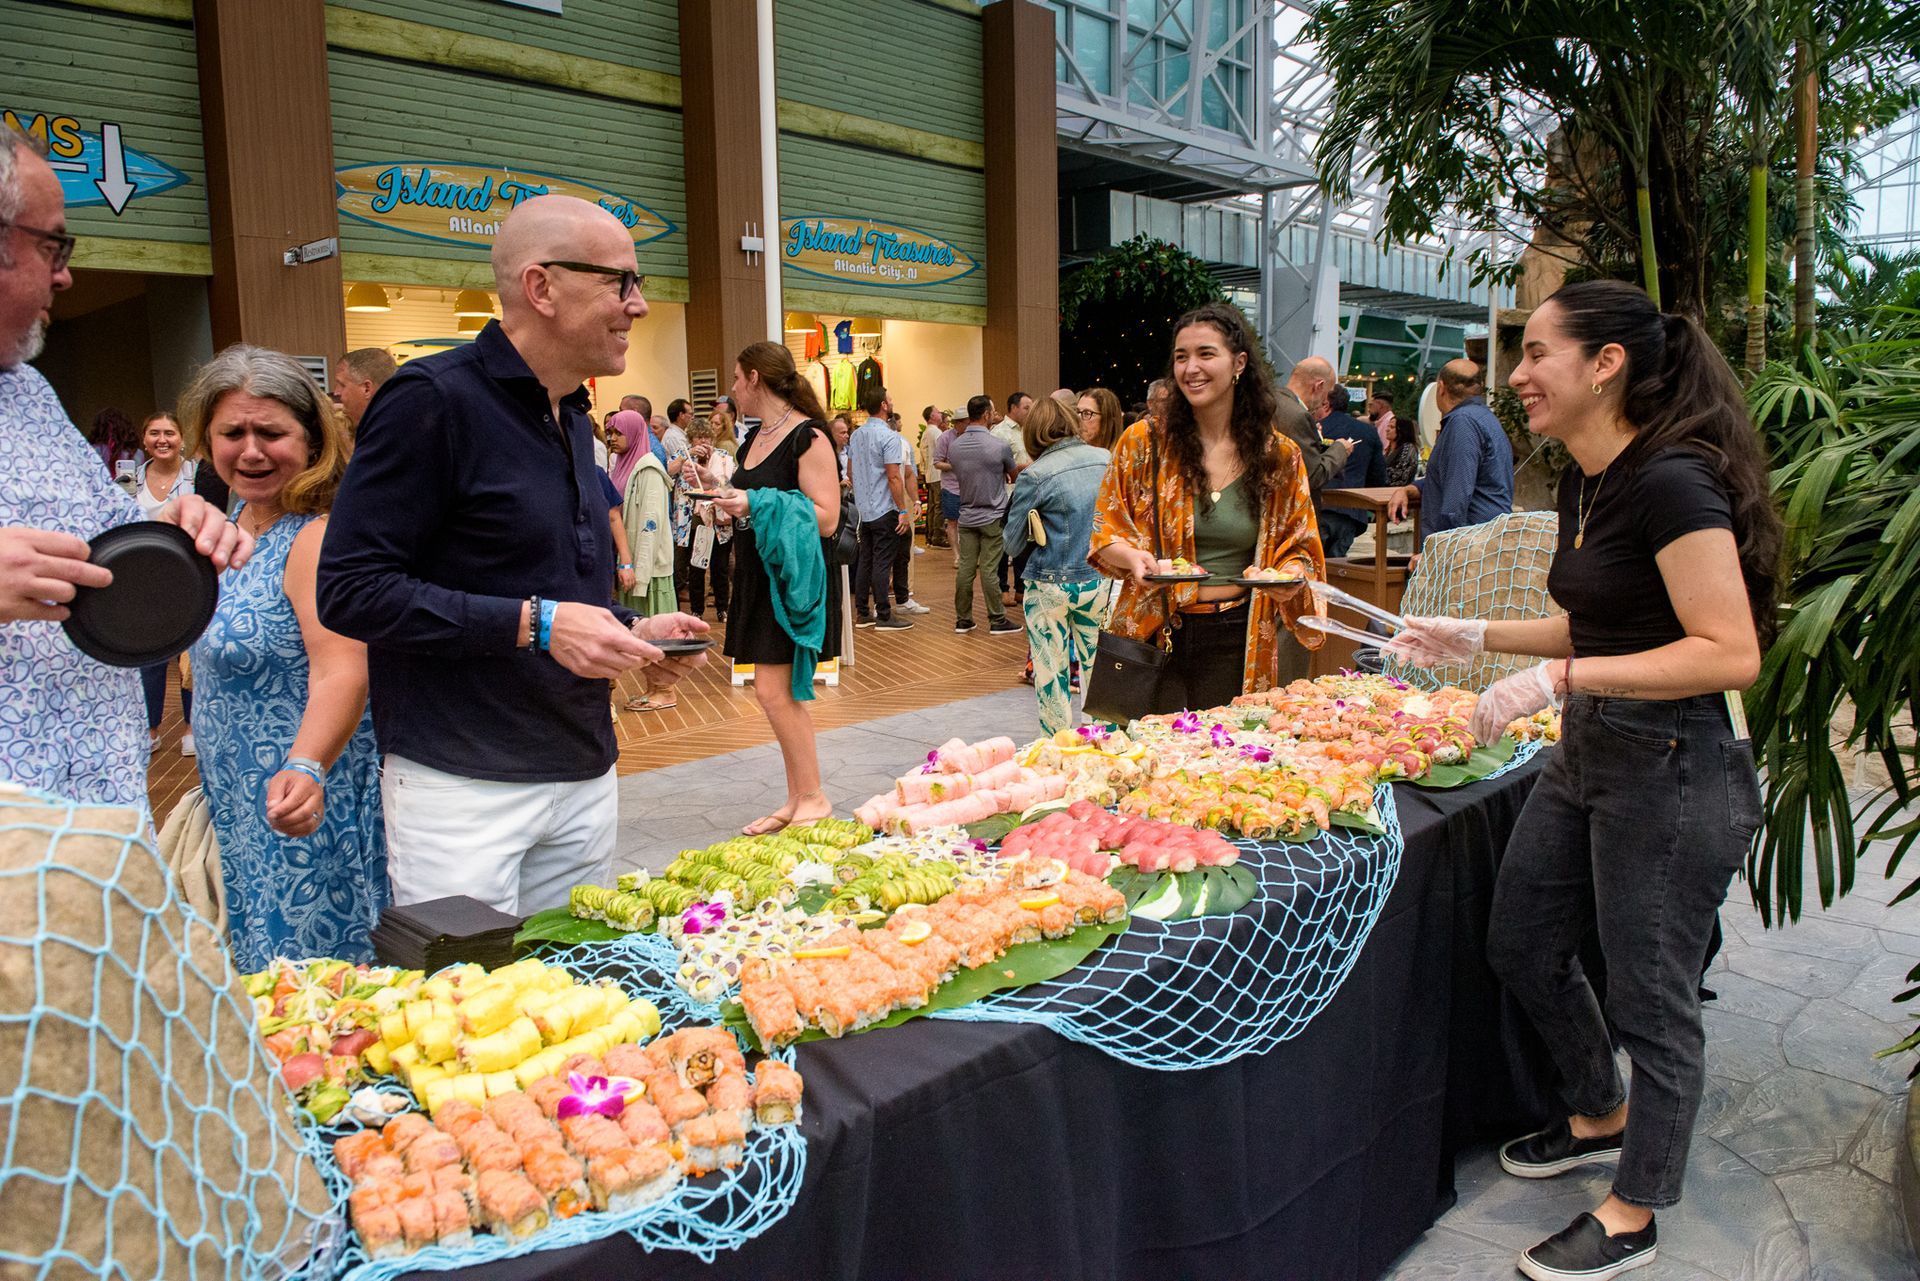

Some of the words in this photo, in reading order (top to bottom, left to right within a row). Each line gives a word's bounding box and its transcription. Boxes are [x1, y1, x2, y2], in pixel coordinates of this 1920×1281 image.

[371, 166, 493, 213] Island
[786, 220, 864, 257] Island
[866, 229, 956, 266] Treasures
[834, 259, 876, 275] Atlantic
[907, 268, 917, 279] NJ
